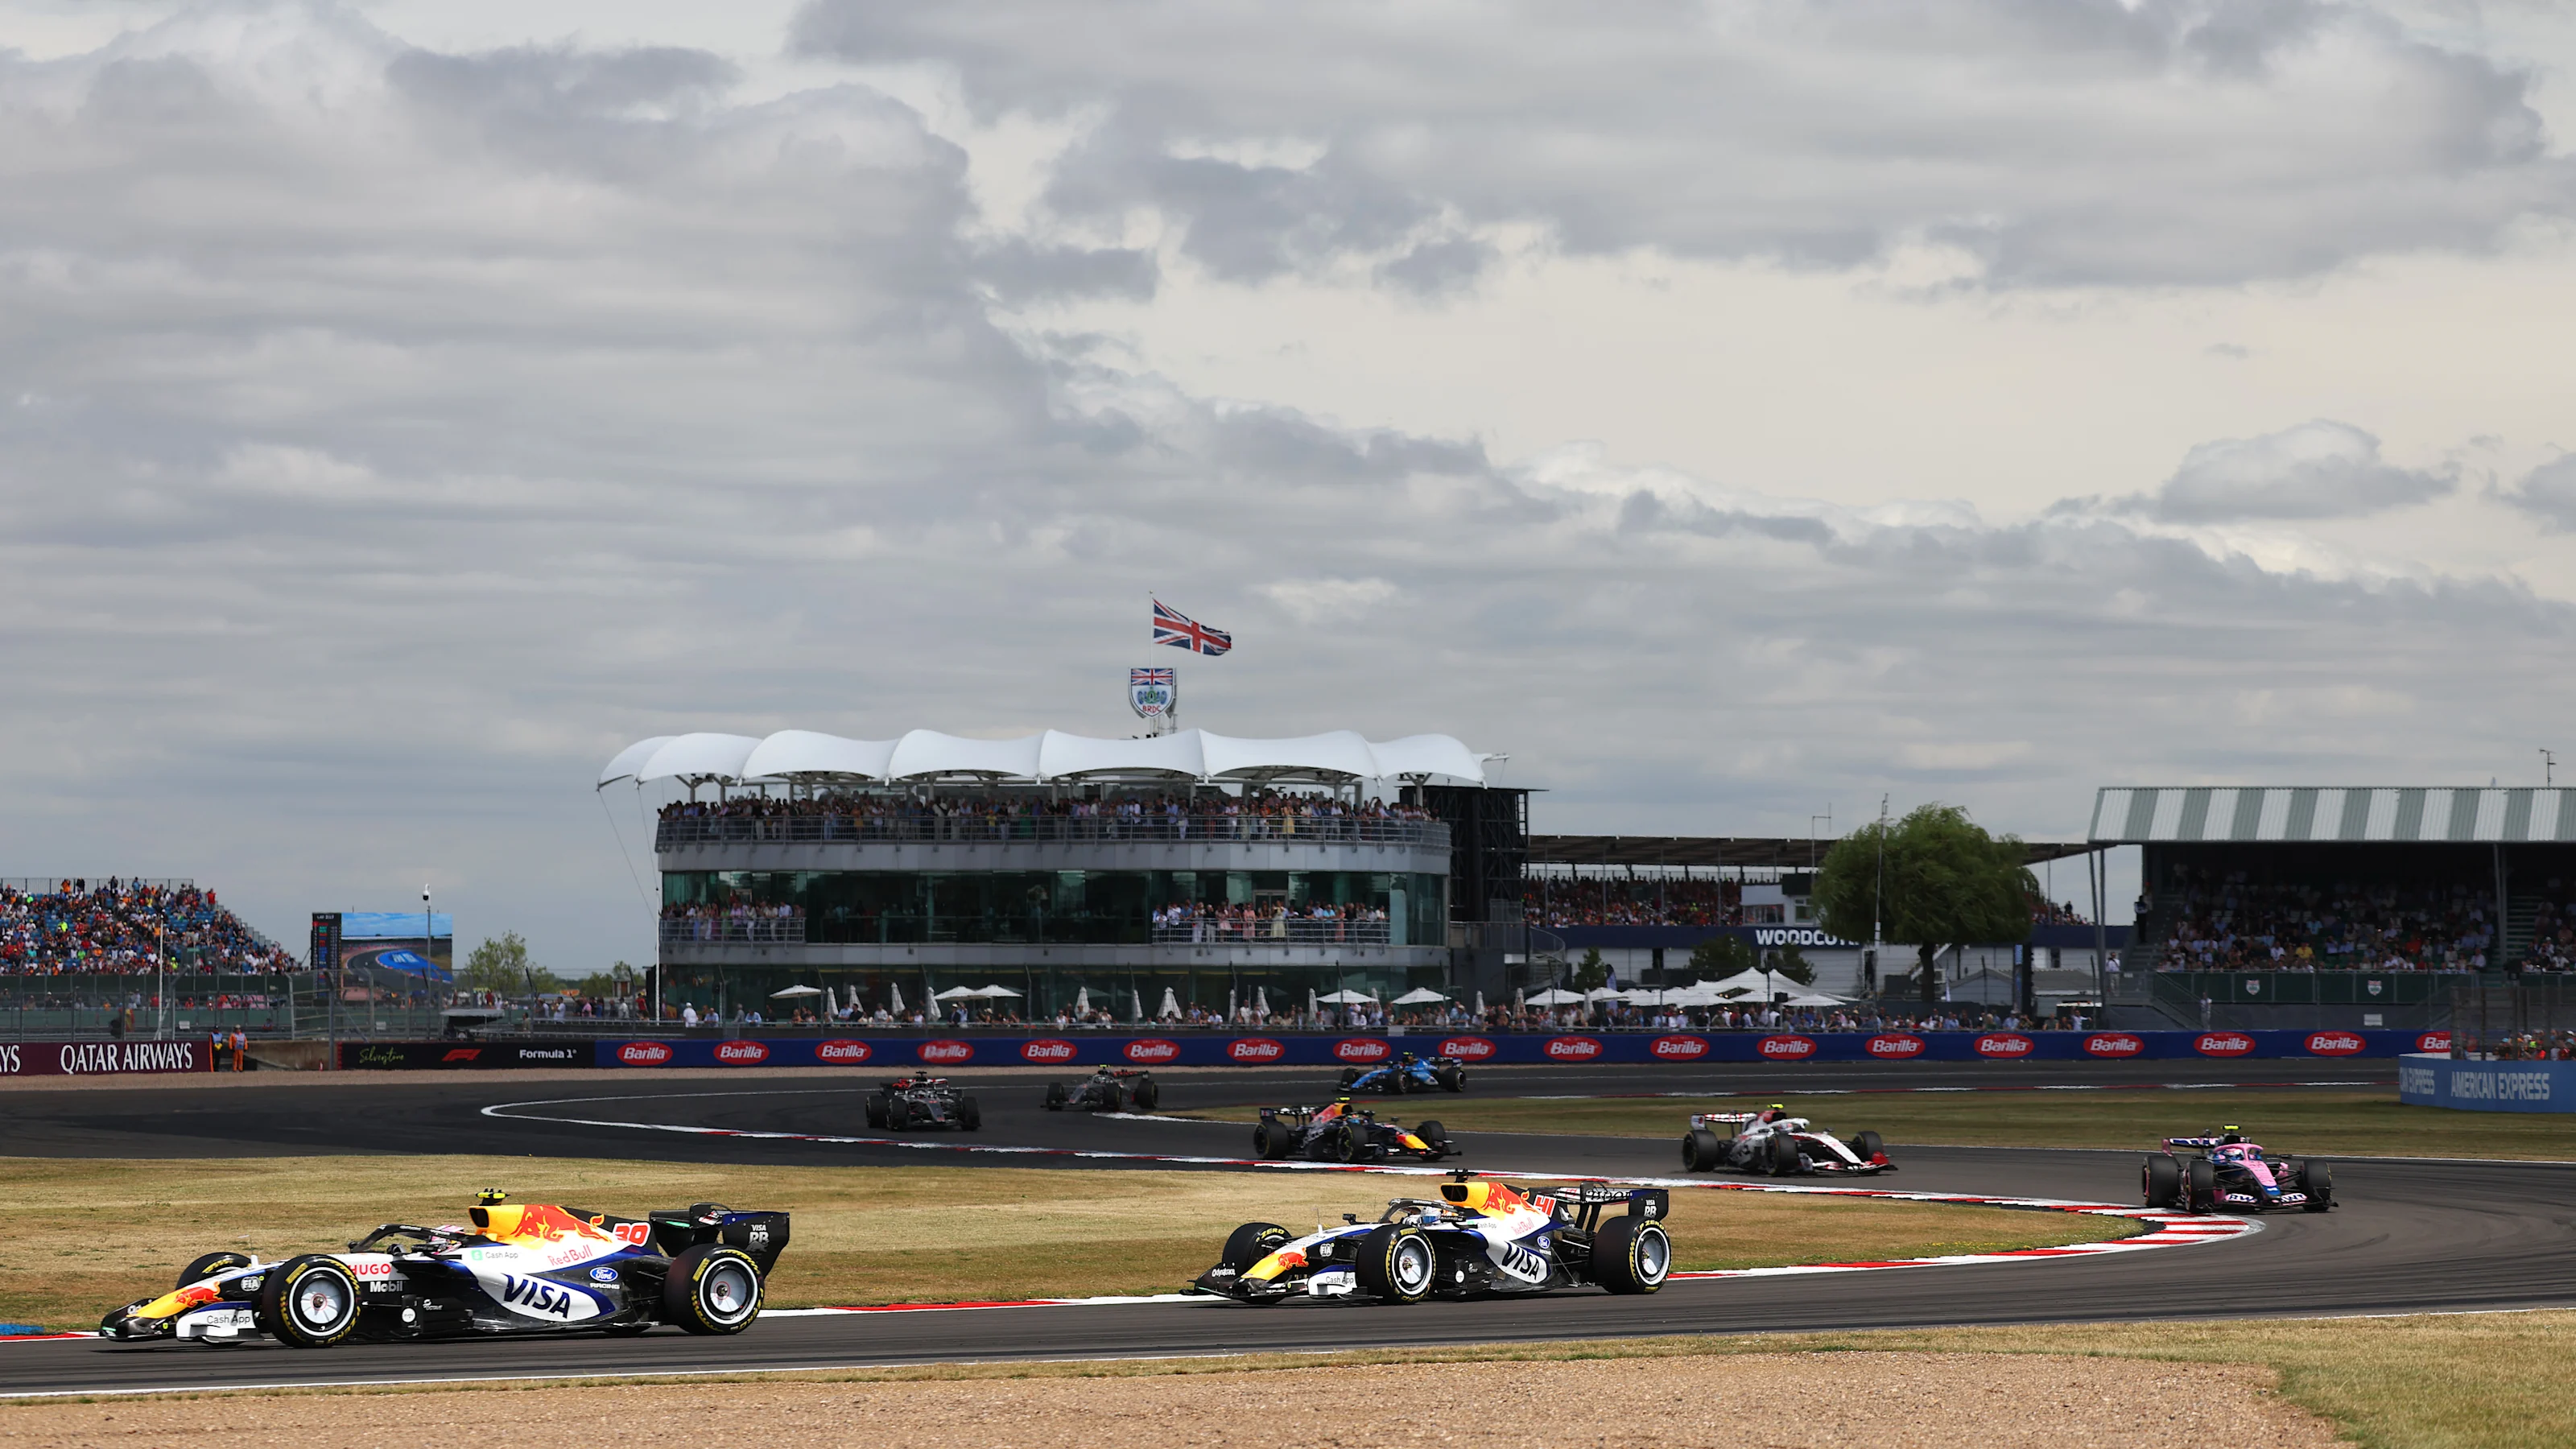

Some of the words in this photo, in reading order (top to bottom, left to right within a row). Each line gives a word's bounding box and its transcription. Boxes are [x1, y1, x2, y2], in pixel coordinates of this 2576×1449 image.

[1142, 705, 1161, 713] BRDC
[1756, 929, 1859, 946] WOODCO
[1234, 1043, 1278, 1056] Barilla
[1340, 1043, 1383, 1056] Barilla
[1445, 1042, 1489, 1055] Barilla
[1550, 1042, 1596, 1055] Barilla
[1657, 1041, 1702, 1054] Barilla
[1764, 1040, 1809, 1053] Barilla
[1872, 1039, 1918, 1052] Barilla
[1981, 1038, 2027, 1052] Barilla
[2091, 1038, 2136, 1051] Barilla
[2202, 1038, 2248, 1051] Barilla
[2311, 1037, 2358, 1050] Barilla
[359, 1046, 404, 1063] Silverstone
[519, 1049, 564, 1059] Formula
[623, 1047, 666, 1059] Barilla
[720, 1046, 762, 1059] Barilla
[822, 1045, 865, 1057] Barilla
[924, 1045, 967, 1058] Barilla
[1027, 1045, 1070, 1057] Barilla
[1130, 1044, 1173, 1058] Barilla
[60, 1044, 119, 1075] QATAR
[122, 1042, 193, 1070] AIRWAYS
[2450, 1071, 2496, 1099] AMERICAN
[2498, 1073, 2550, 1100] EXPRESS
[1534, 1196, 1555, 1216] 41
[1645, 1220, 1665, 1230] ZERO
[613, 1224, 649, 1245] 30
[1261, 1228, 1285, 1239] ZERO
[505, 1252, 518, 1260] App
[547, 1249, 571, 1265] Red
[570, 1245, 592, 1261] Bull
[1502, 1241, 1540, 1280] VISA
[349, 1264, 391, 1275] HUGO
[595, 1269, 613, 1280] Ford
[369, 1281, 402, 1293] Mobil
[1343, 1277, 1354, 1285] App
[500, 1273, 571, 1319] VISA
[207, 1315, 229, 1324] Cash
[231, 1315, 251, 1325] App
